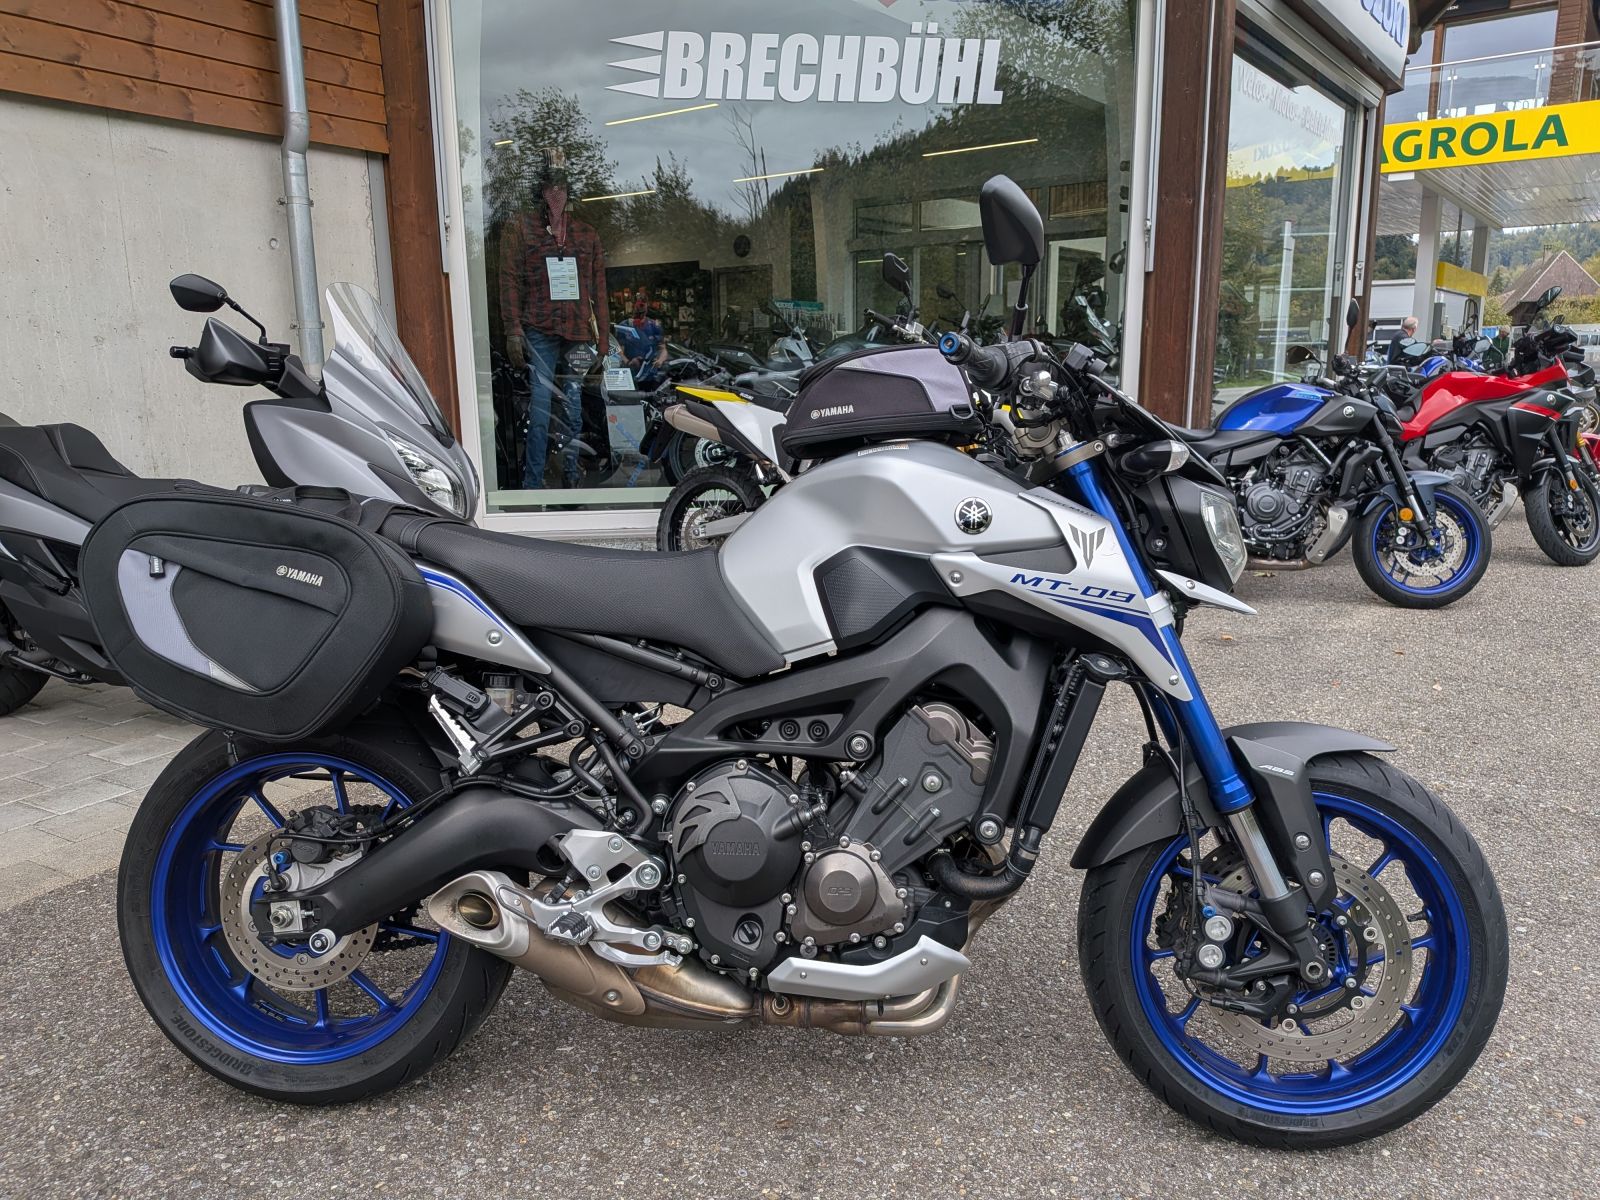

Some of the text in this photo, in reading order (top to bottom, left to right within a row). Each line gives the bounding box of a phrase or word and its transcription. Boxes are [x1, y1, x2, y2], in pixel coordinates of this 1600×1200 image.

[663, 22, 1003, 105] BRECHBÜHL
[820, 404, 854, 417] YAMAHA
[286, 567, 323, 587] YAMAHA
[1010, 573, 1136, 604] MT-09
[1257, 764, 1296, 776] ABS
[711, 840, 761, 856] YAMAHA
[170, 1013, 256, 1076] BRIDGESTONE
